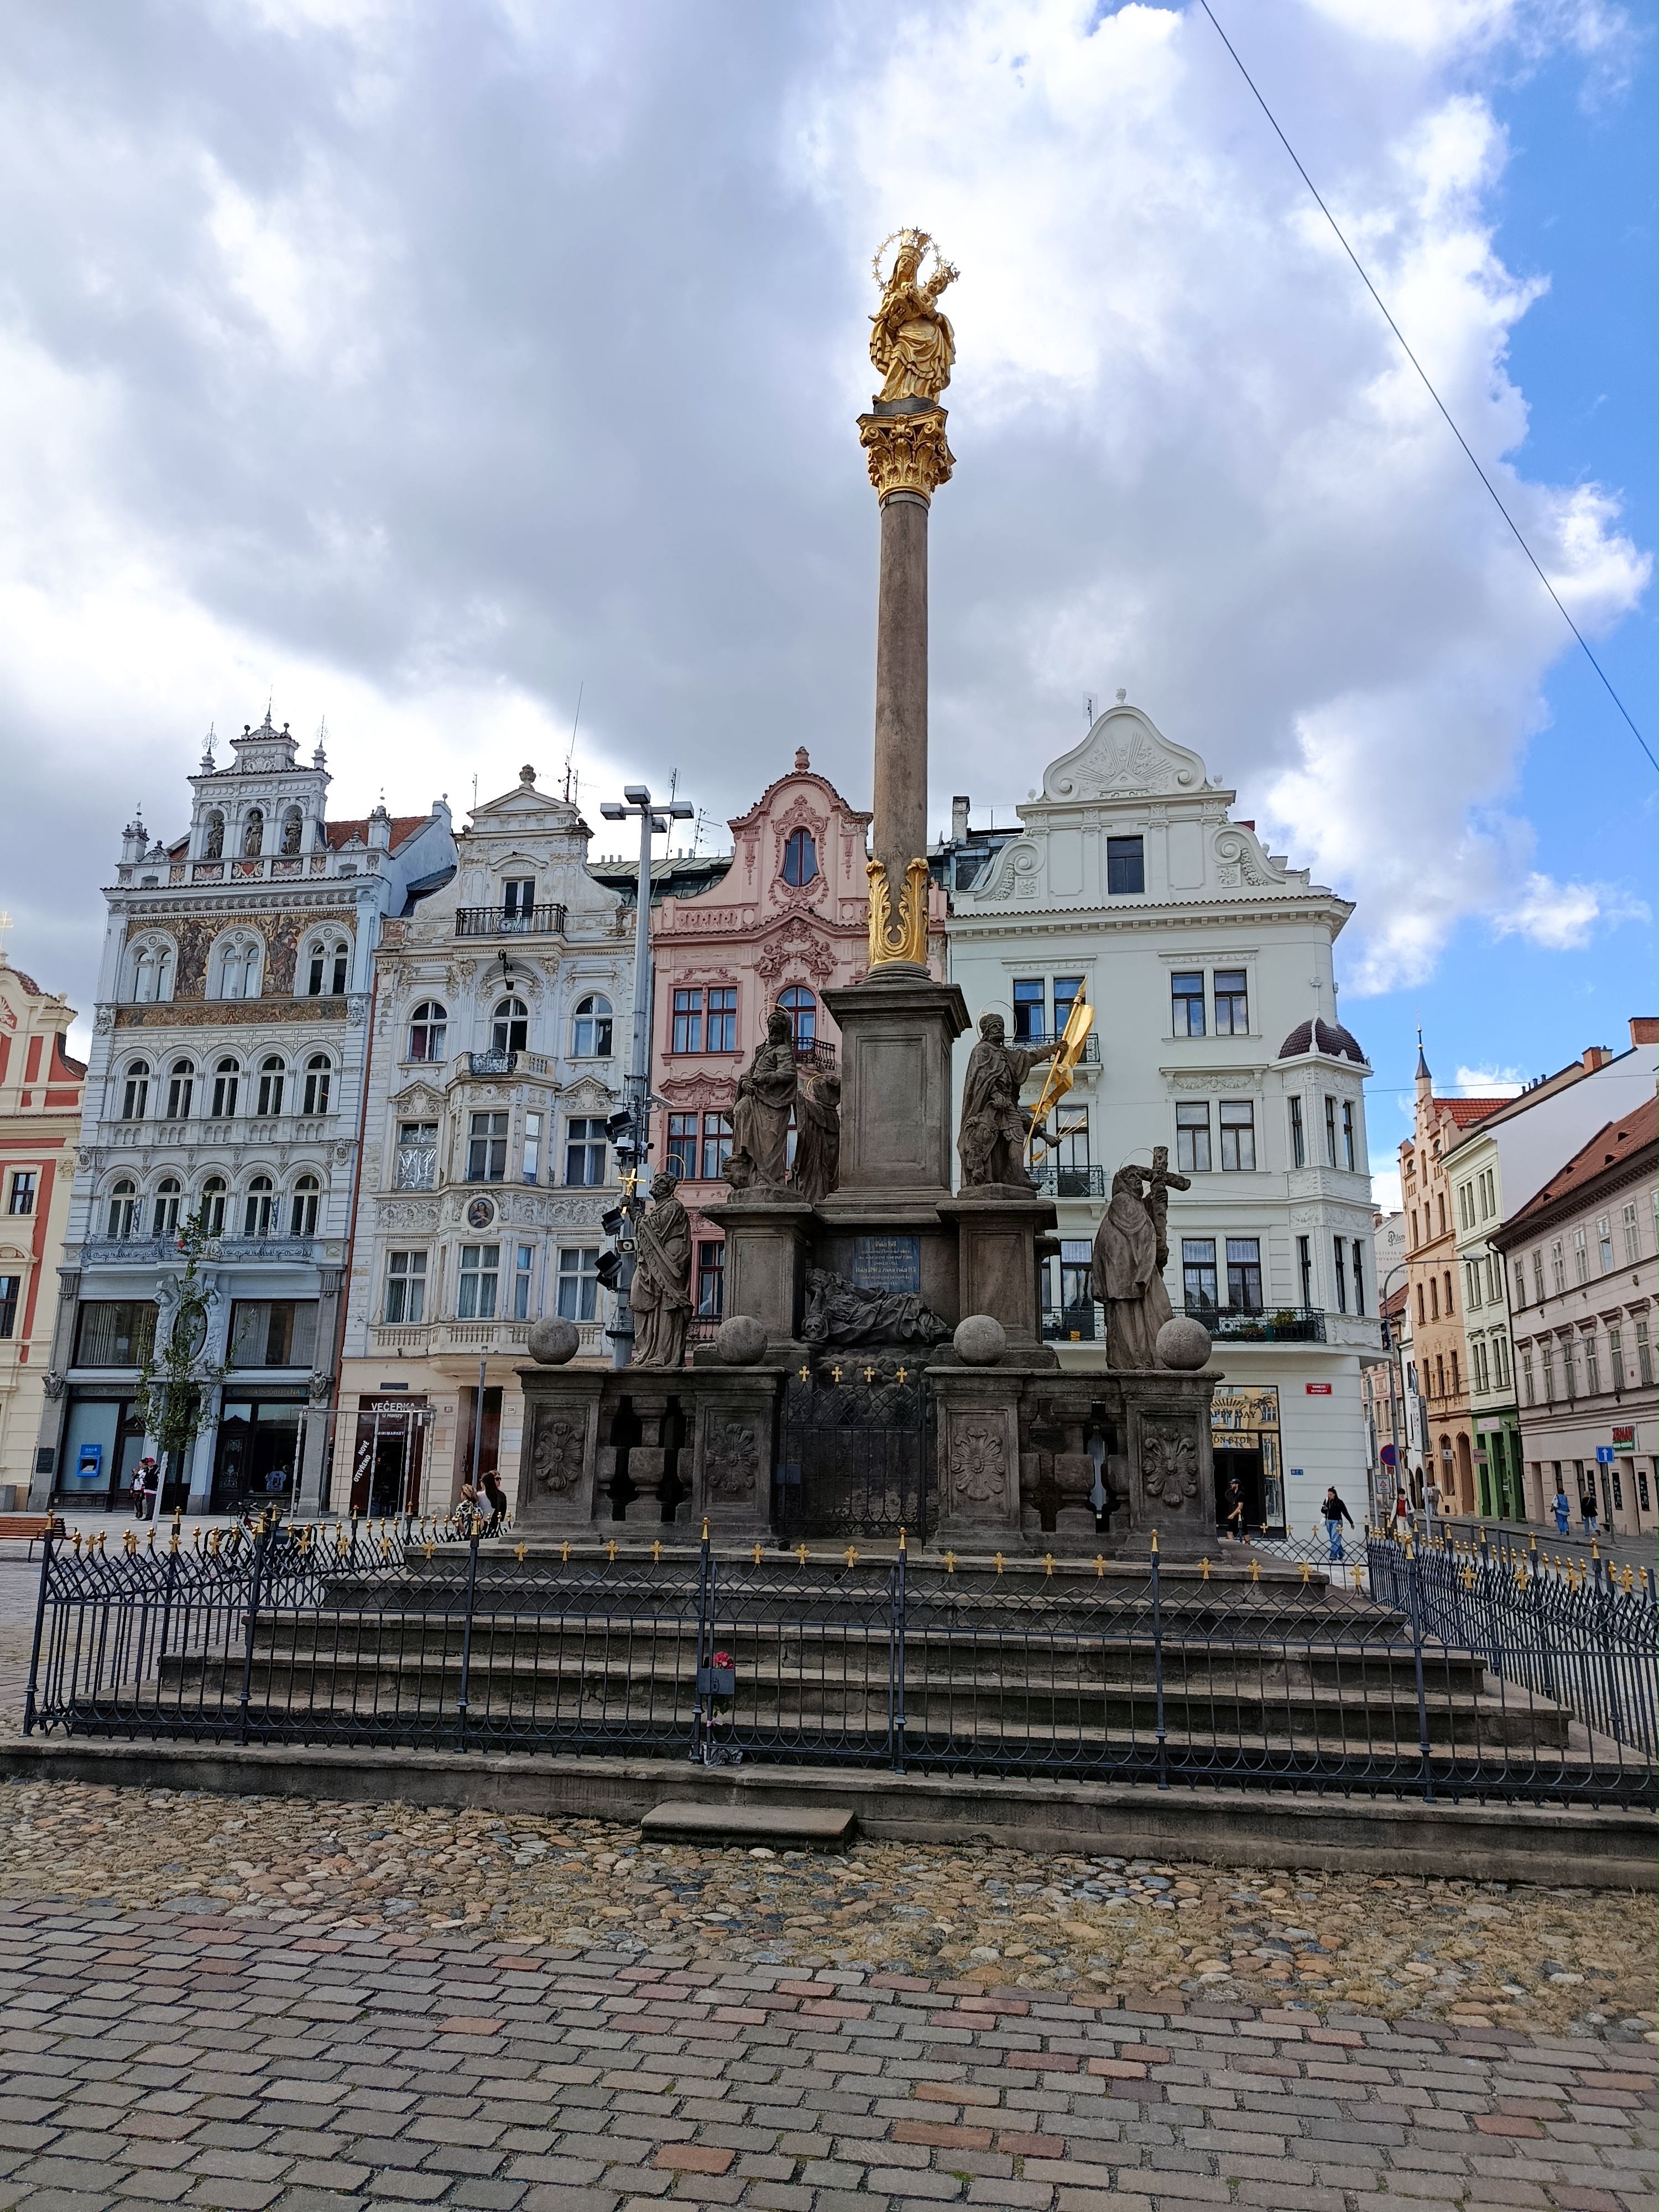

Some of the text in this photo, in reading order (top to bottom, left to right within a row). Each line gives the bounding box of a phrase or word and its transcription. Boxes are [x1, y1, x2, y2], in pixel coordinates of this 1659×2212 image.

[1388, 1230, 1405, 1246] Pilsn
[1235, 1410, 1256, 1418] DAY
[357, 1440, 370, 1456] NOVÉ
[353, 1454, 371, 1483] OTEVŘENO
